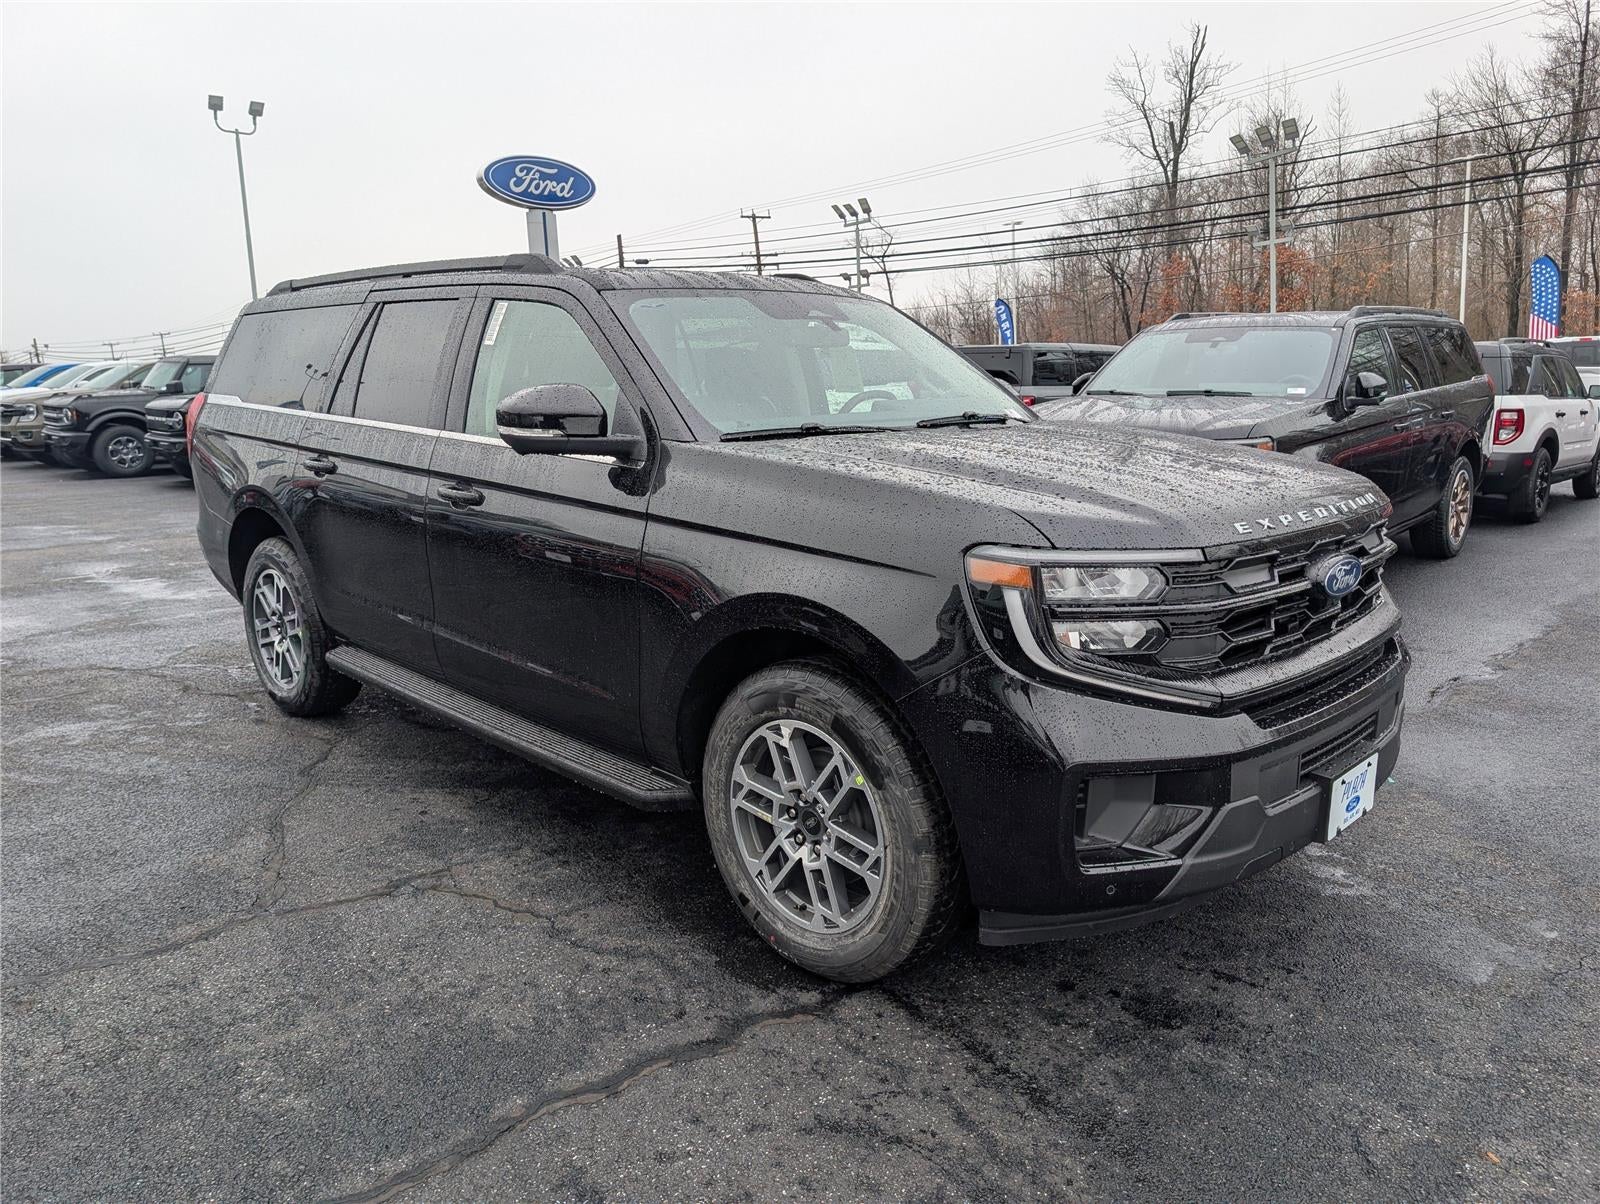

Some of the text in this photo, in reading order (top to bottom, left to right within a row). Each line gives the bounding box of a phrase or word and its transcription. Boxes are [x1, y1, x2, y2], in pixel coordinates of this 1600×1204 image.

[509, 163, 574, 198] Ford
[1233, 492, 1377, 534] EXPEDITION
[1333, 564, 1356, 590] Ford
[1341, 769, 1368, 803] PLAZA
